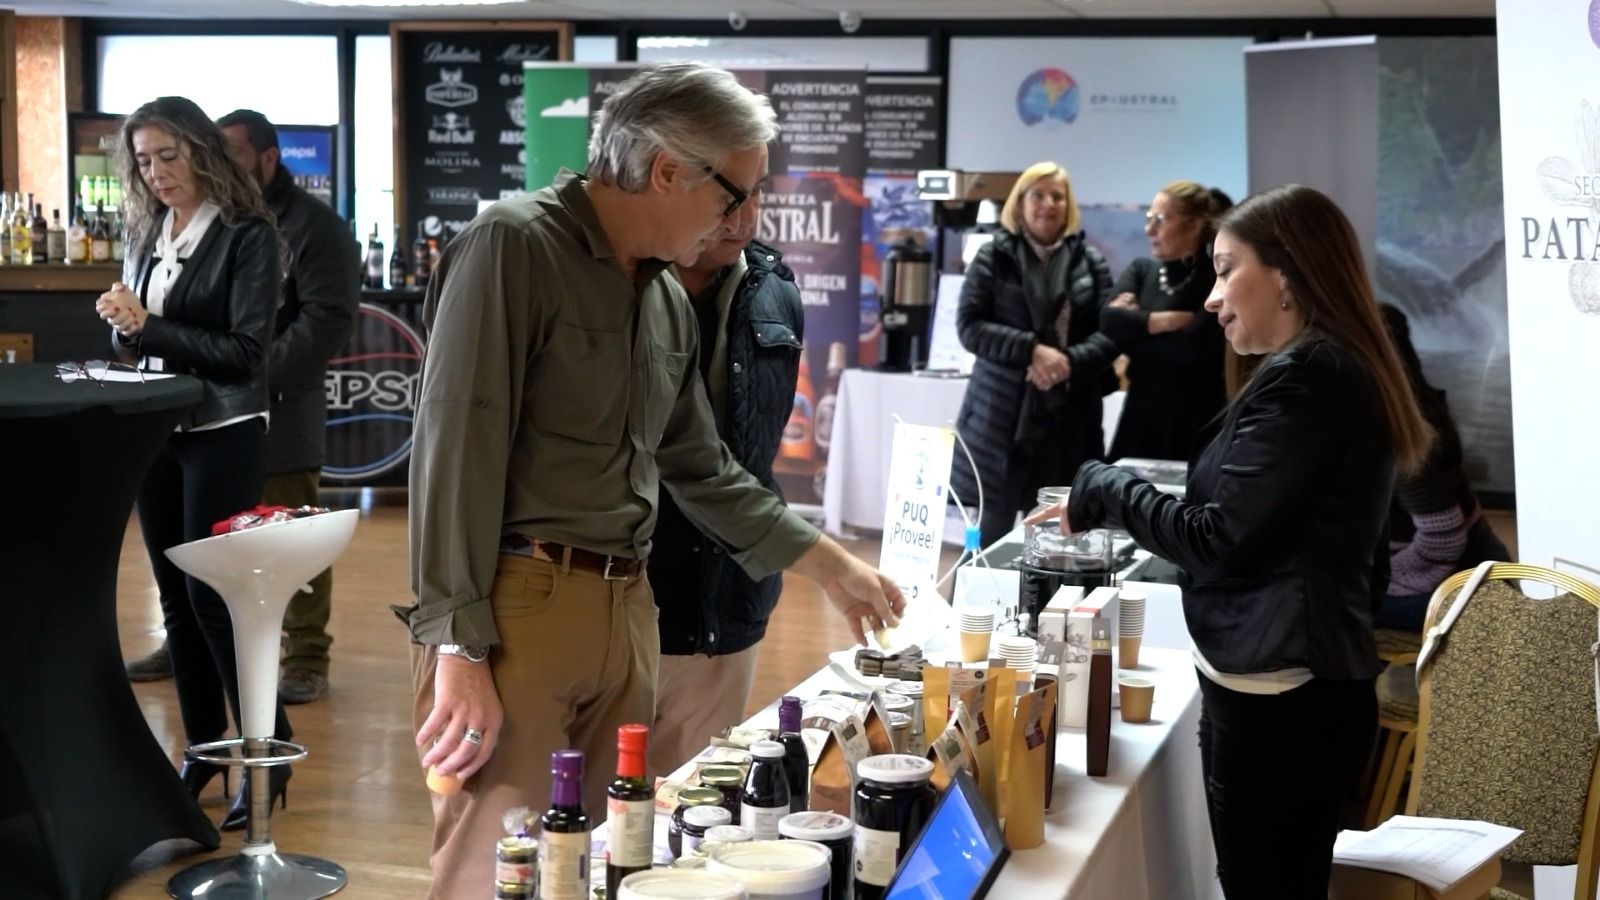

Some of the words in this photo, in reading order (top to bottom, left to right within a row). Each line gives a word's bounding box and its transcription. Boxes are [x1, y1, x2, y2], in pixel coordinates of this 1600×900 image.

[771, 83, 860, 96] ADVERTENCIA
[428, 130, 451, 142] Red
[452, 129, 476, 142] Bull
[281, 146, 317, 159] pepsi
[425, 158, 480, 167] MOLINA
[803, 275, 847, 291] ORIGEN
[902, 501, 929, 526] PUQ
[890, 522, 935, 550] ¡Provee!
